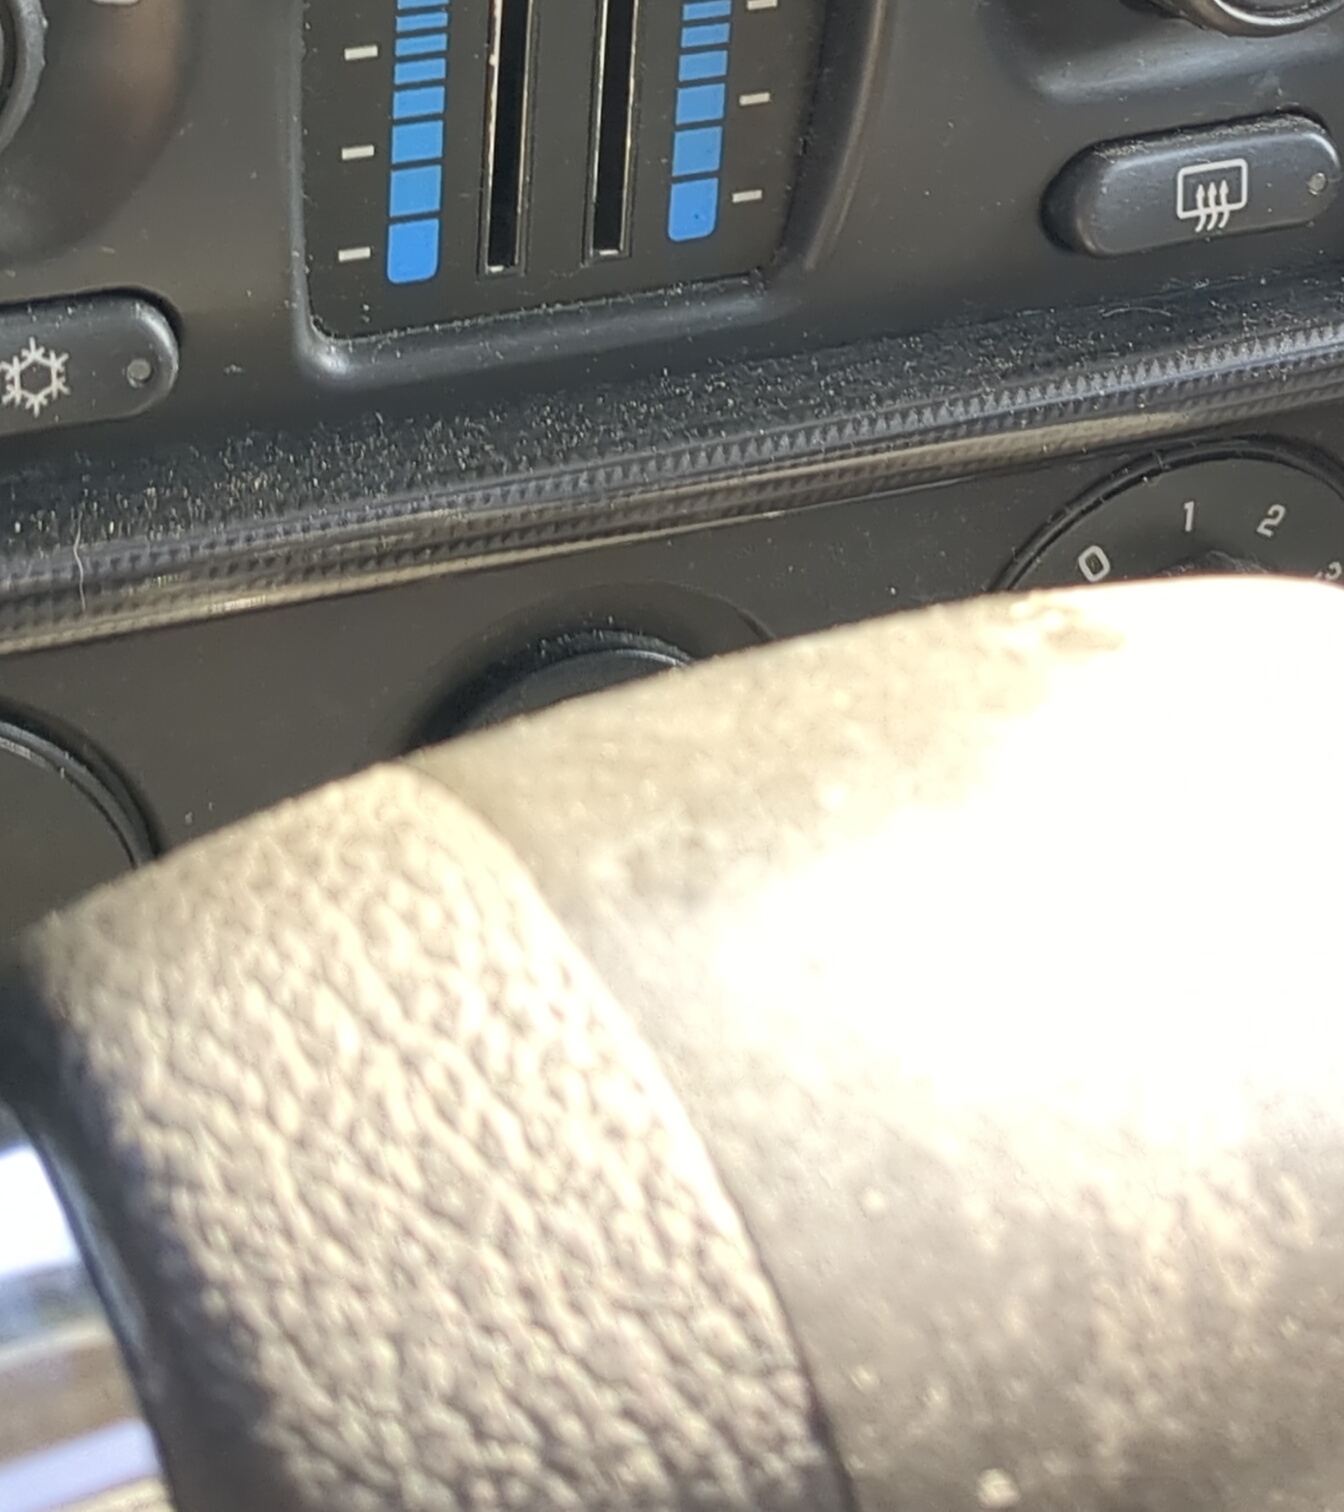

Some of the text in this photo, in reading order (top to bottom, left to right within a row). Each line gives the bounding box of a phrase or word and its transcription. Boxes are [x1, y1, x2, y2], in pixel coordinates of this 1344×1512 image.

[1182, 500, 1196, 533] 1
[1256, 503, 1287, 538] 2
[1077, 544, 1112, 584] 0
